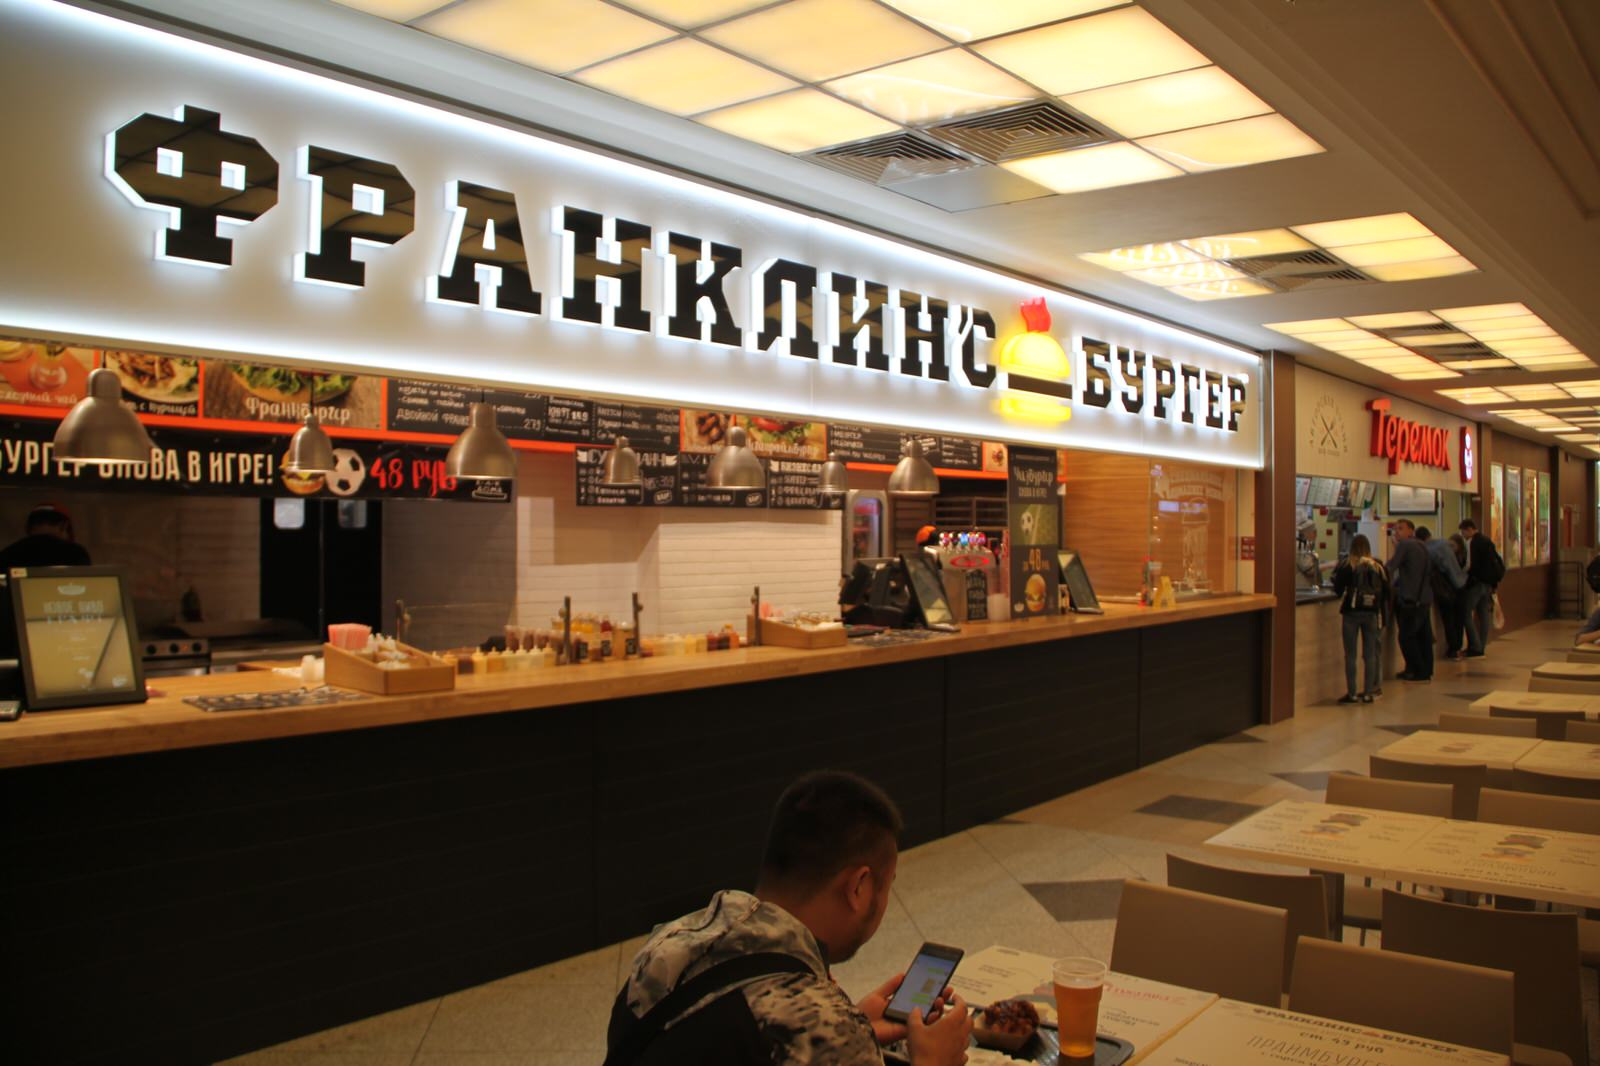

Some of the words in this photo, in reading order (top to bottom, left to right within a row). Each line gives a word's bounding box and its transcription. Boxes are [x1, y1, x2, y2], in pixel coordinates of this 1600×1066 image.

[1078, 336, 1248, 432] БУРГЕР
[1366, 398, 1451, 475] Теремок
[187, 450, 201, 482] В
[209, 452, 274, 485] ИГРЕ!
[370, 457, 404, 489] 48
[1381, 1032, 1459, 1054] БУРГЕР
